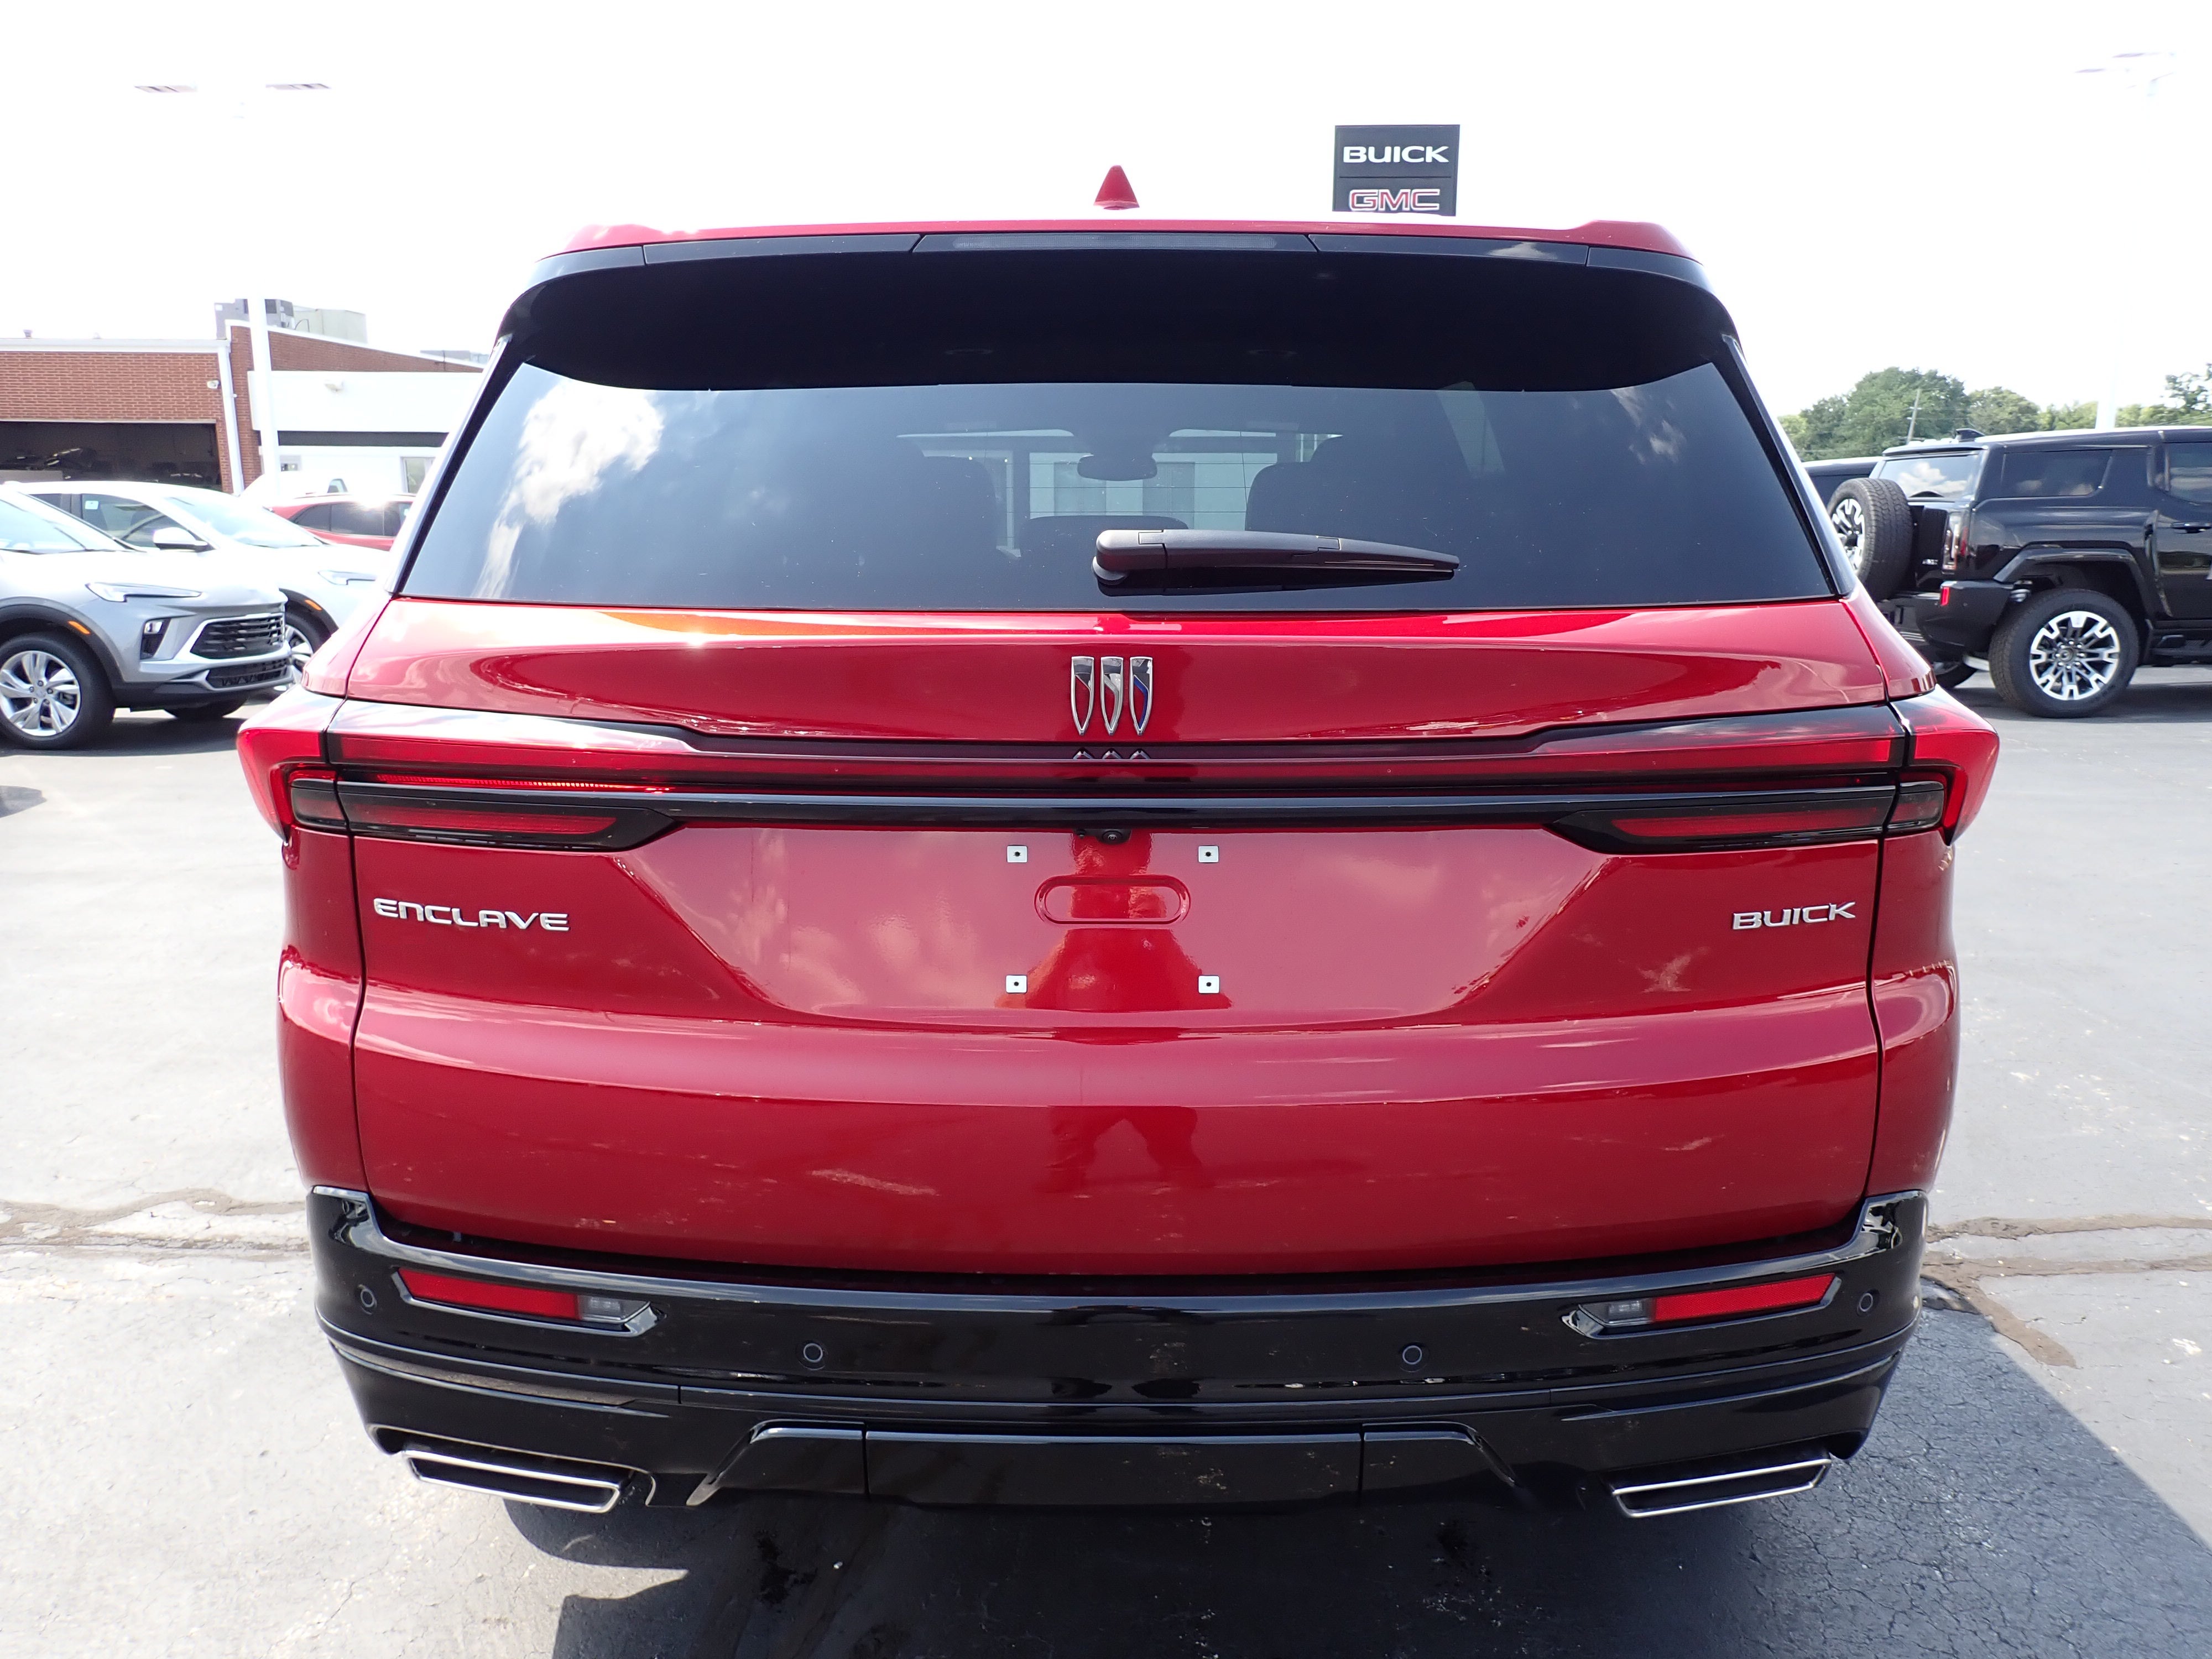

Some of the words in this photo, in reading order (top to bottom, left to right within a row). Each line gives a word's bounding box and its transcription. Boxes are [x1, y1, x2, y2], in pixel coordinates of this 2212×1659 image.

[1343, 145, 1449, 163] BUICK
[1349, 189, 1440, 211] GMC
[373, 898, 570, 931] ENCLAVE
[1733, 901, 1856, 930] BUICK
